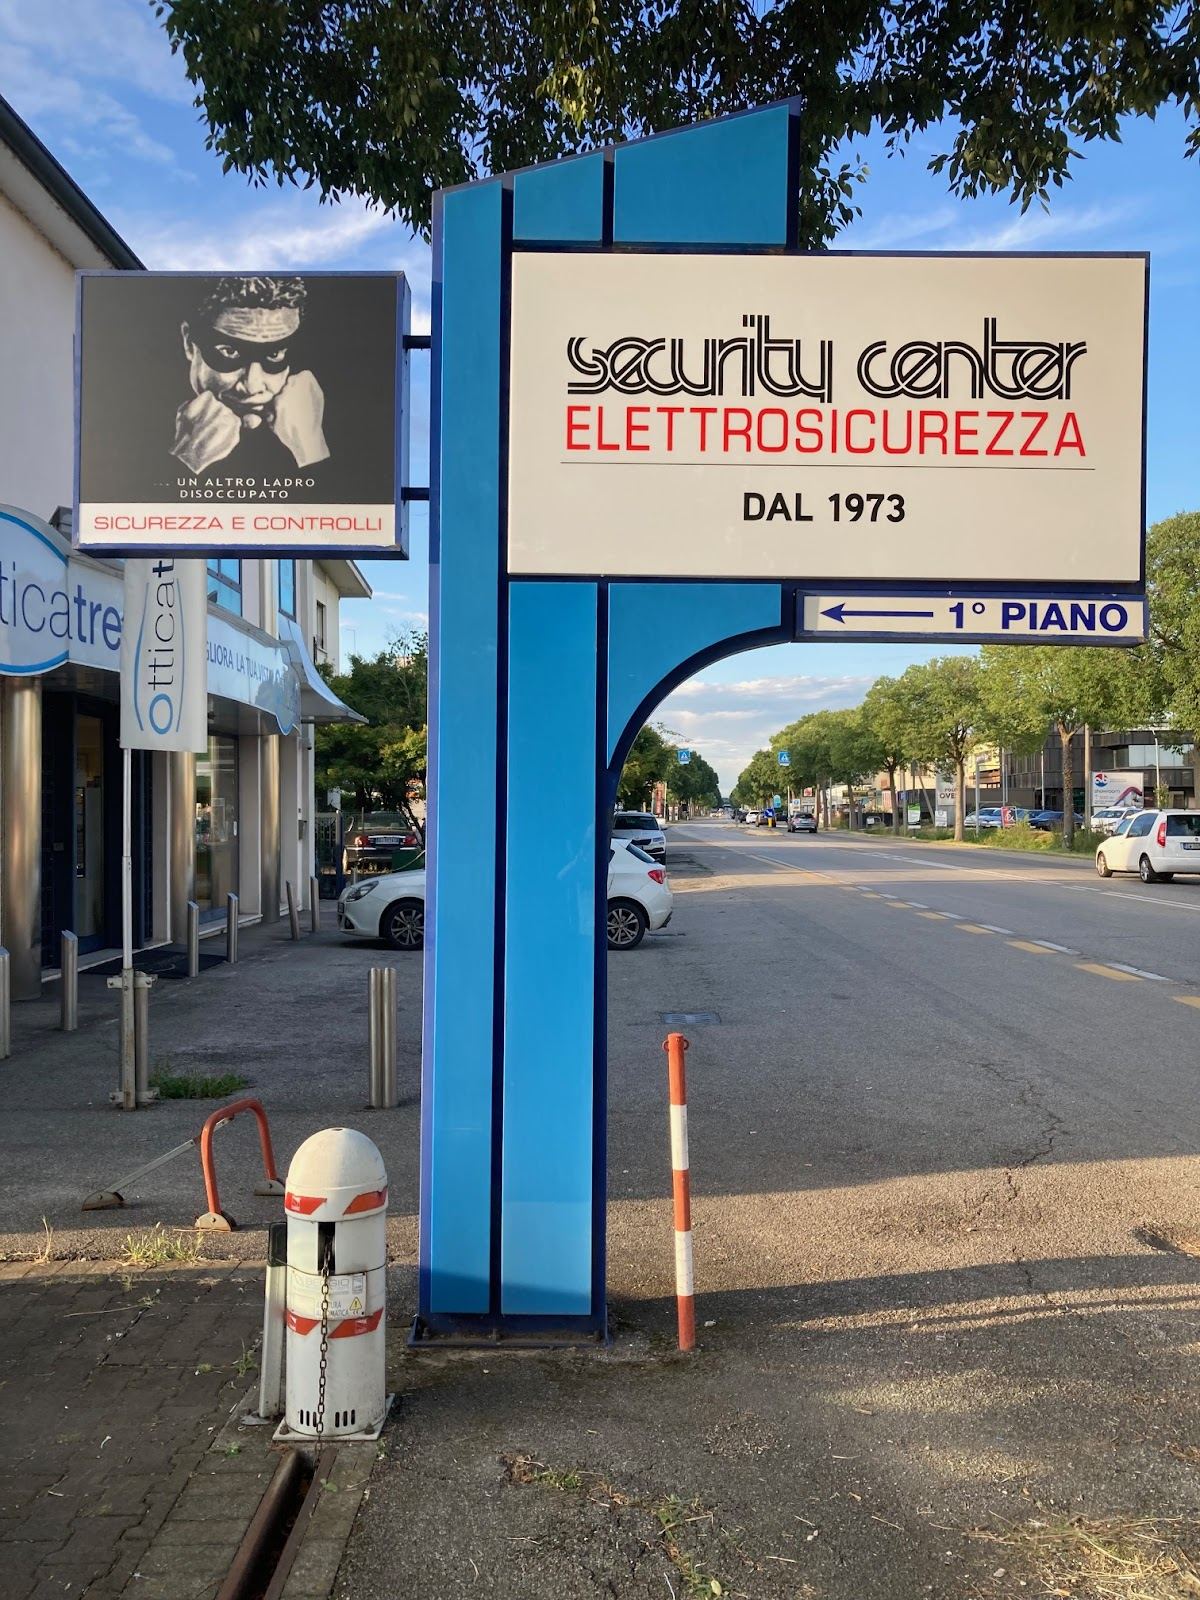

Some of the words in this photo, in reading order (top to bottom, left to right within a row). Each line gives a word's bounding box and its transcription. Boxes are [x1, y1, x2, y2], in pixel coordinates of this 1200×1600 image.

[567, 315, 833, 403] security
[857, 317, 1088, 400] center
[566, 405, 1087, 457] ELETTROSICUREZZA
[177, 477, 198, 487] UN
[205, 477, 256, 487] ALTRO
[263, 478, 316, 487] LADRO
[180, 489, 289, 499] DISOCCUPATO
[743, 493, 813, 522] DAL
[828, 493, 906, 523] 1973
[93, 516, 223, 530] SICUREZZA
[232, 516, 245, 530] E
[253, 516, 382, 531] CONTROLLI
[1000, 601, 1129, 633] PIANO
